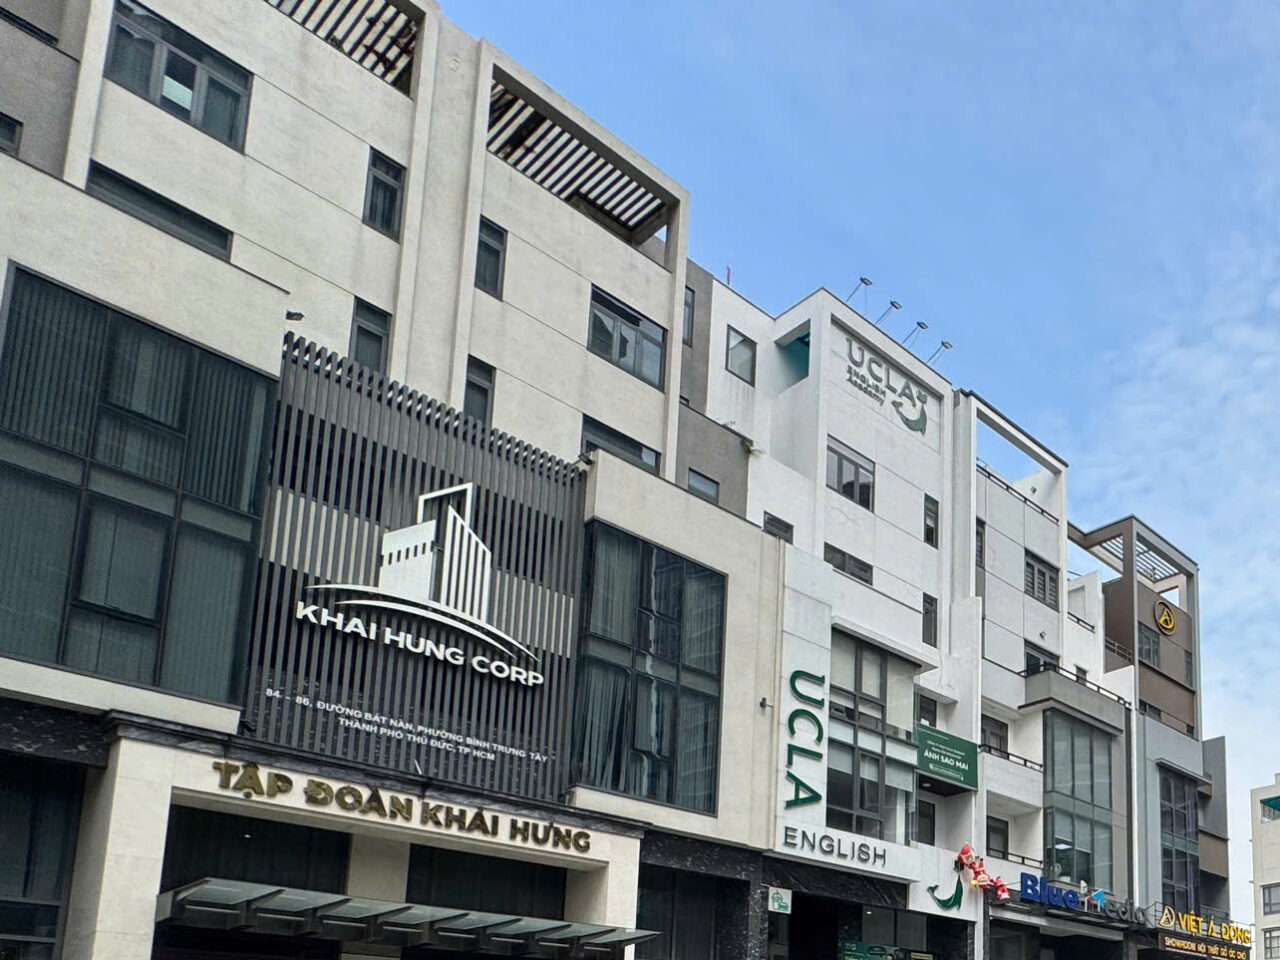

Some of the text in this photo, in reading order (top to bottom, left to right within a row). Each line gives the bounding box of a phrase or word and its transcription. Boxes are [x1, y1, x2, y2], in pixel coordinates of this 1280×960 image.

[845, 336, 917, 408] UCLA
[296, 601, 544, 687] KHAI HUNG CORP
[265, 688, 281, 698] 84
[317, 700, 362, 719] ĐƯỜNG
[417, 725, 463, 743] PHƯỜNG
[466, 736, 490, 750] BÌNH
[338, 717, 378, 733] THÀNH
[457, 745, 471, 755] TP
[472, 749, 496, 761] HCM
[783, 669, 826, 810] UCLA
[940, 755, 955, 767] SAO
[955, 760, 969, 771] MAI
[213, 760, 294, 800] TẬP
[303, 776, 413, 822] ĐOÀN
[509, 817, 592, 852] HƯNG
[783, 826, 887, 867] ENGLISH
[1020, 872, 1080, 910] Blue
